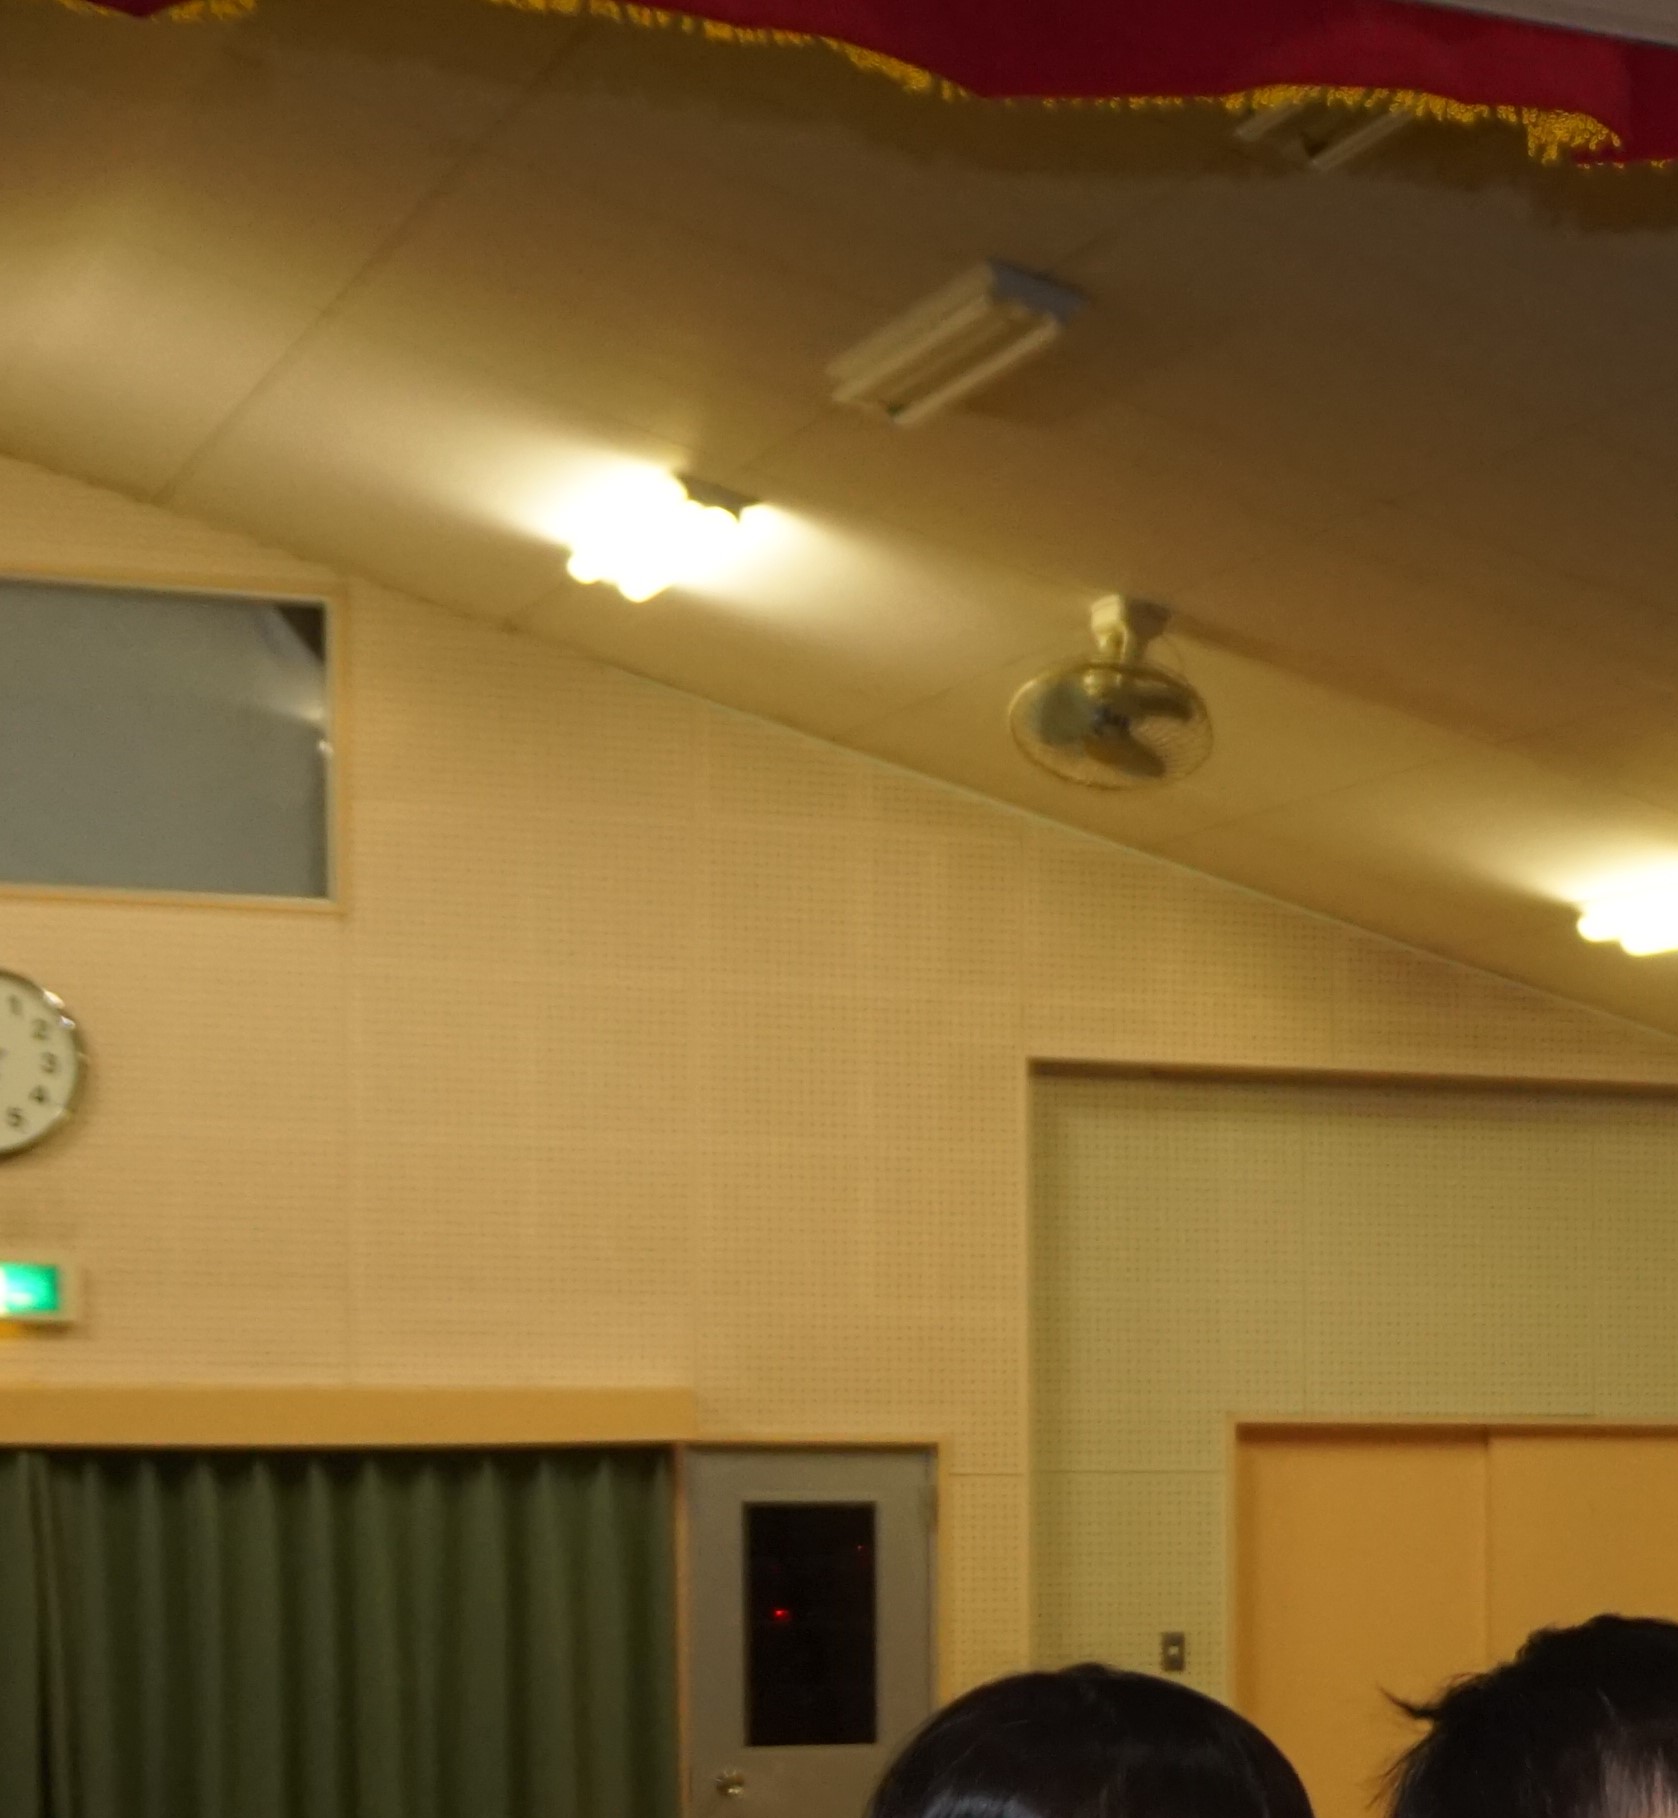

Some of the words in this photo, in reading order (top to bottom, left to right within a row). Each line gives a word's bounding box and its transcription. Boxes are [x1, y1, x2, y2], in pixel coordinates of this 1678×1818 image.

[31, 1018, 49, 1041] 2
[41, 1051, 58, 1074] 3
[29, 1084, 49, 1104] 4
